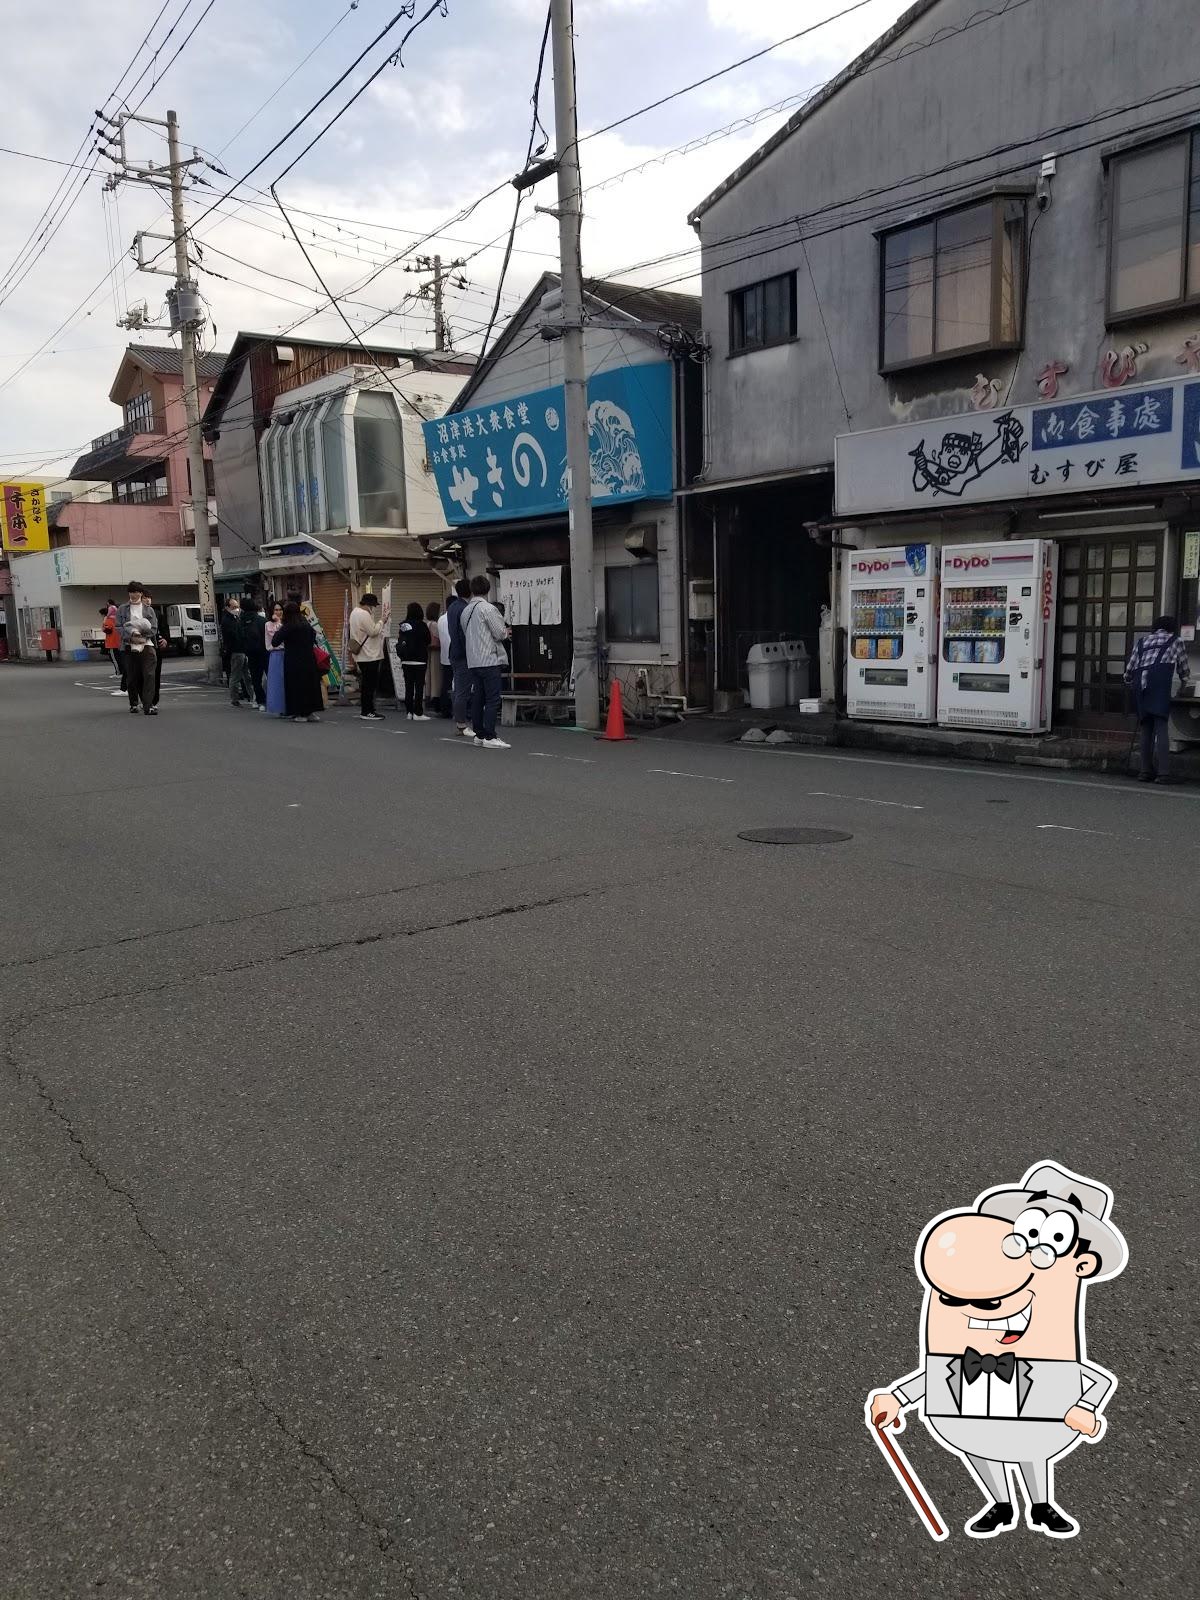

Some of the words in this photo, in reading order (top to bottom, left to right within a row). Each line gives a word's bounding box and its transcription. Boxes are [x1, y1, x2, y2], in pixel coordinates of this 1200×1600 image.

[437, 401, 531, 444] 沼津港大衆食堂
[1030, 452, 1138, 485] むすび屋
[10, 491, 28, 542] 千本一
[31, 489, 41, 524] さかなや
[858, 560, 890, 575] DyDo
[953, 555, 990, 571] DyDo
[1043, 569, 1053, 620] DyDo
